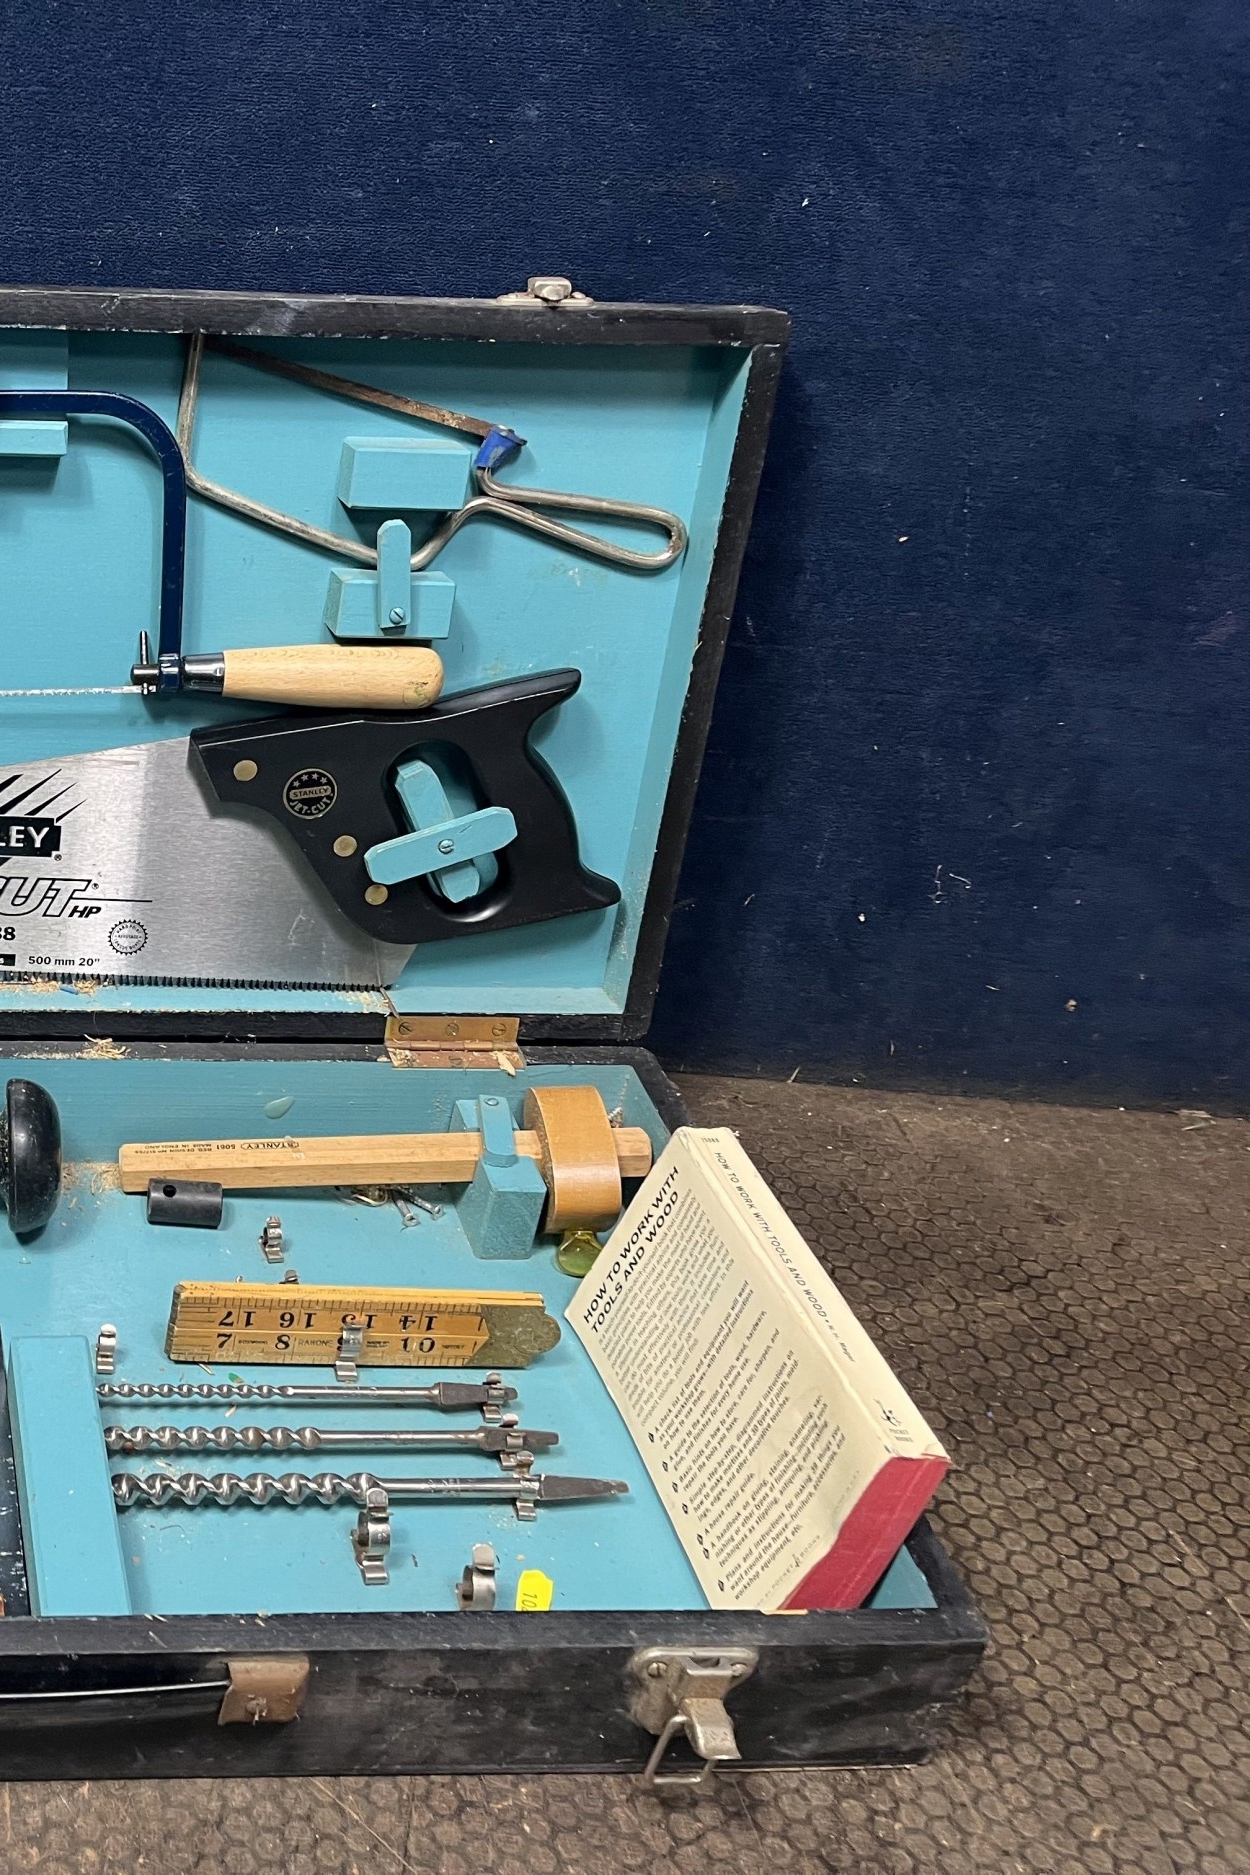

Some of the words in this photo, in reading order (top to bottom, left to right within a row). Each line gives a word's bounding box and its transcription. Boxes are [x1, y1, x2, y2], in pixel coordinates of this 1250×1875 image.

[293, 787, 329, 797] STANLEY
[290, 797, 331, 814] JET-CUT
[68, 905, 101, 918] HP
[28, 956, 51, 966] 500
[54, 958, 75, 967] mm
[714, 1152, 730, 1169] HOW
[728, 1172, 739, 1183] TO
[736, 1186, 756, 1209] WORK
[753, 1212, 771, 1232] WITH
[768, 1235, 792, 1264] TOOLS
[787, 1267, 806, 1286] AND
[803, 1289, 827, 1317] WOOD
[583, 1282, 606, 1323] HOW
[606, 1261, 620, 1282] TO
[620, 1210, 654, 1259] WORK
[652, 1166, 678, 1208] WITH
[591, 1282, 623, 1333] TOOLS
[624, 1246, 645, 1282] AND
[645, 1191, 678, 1242] WOOD
[216, 1333, 232, 1349] 7
[275, 1334, 290, 1350] 8
